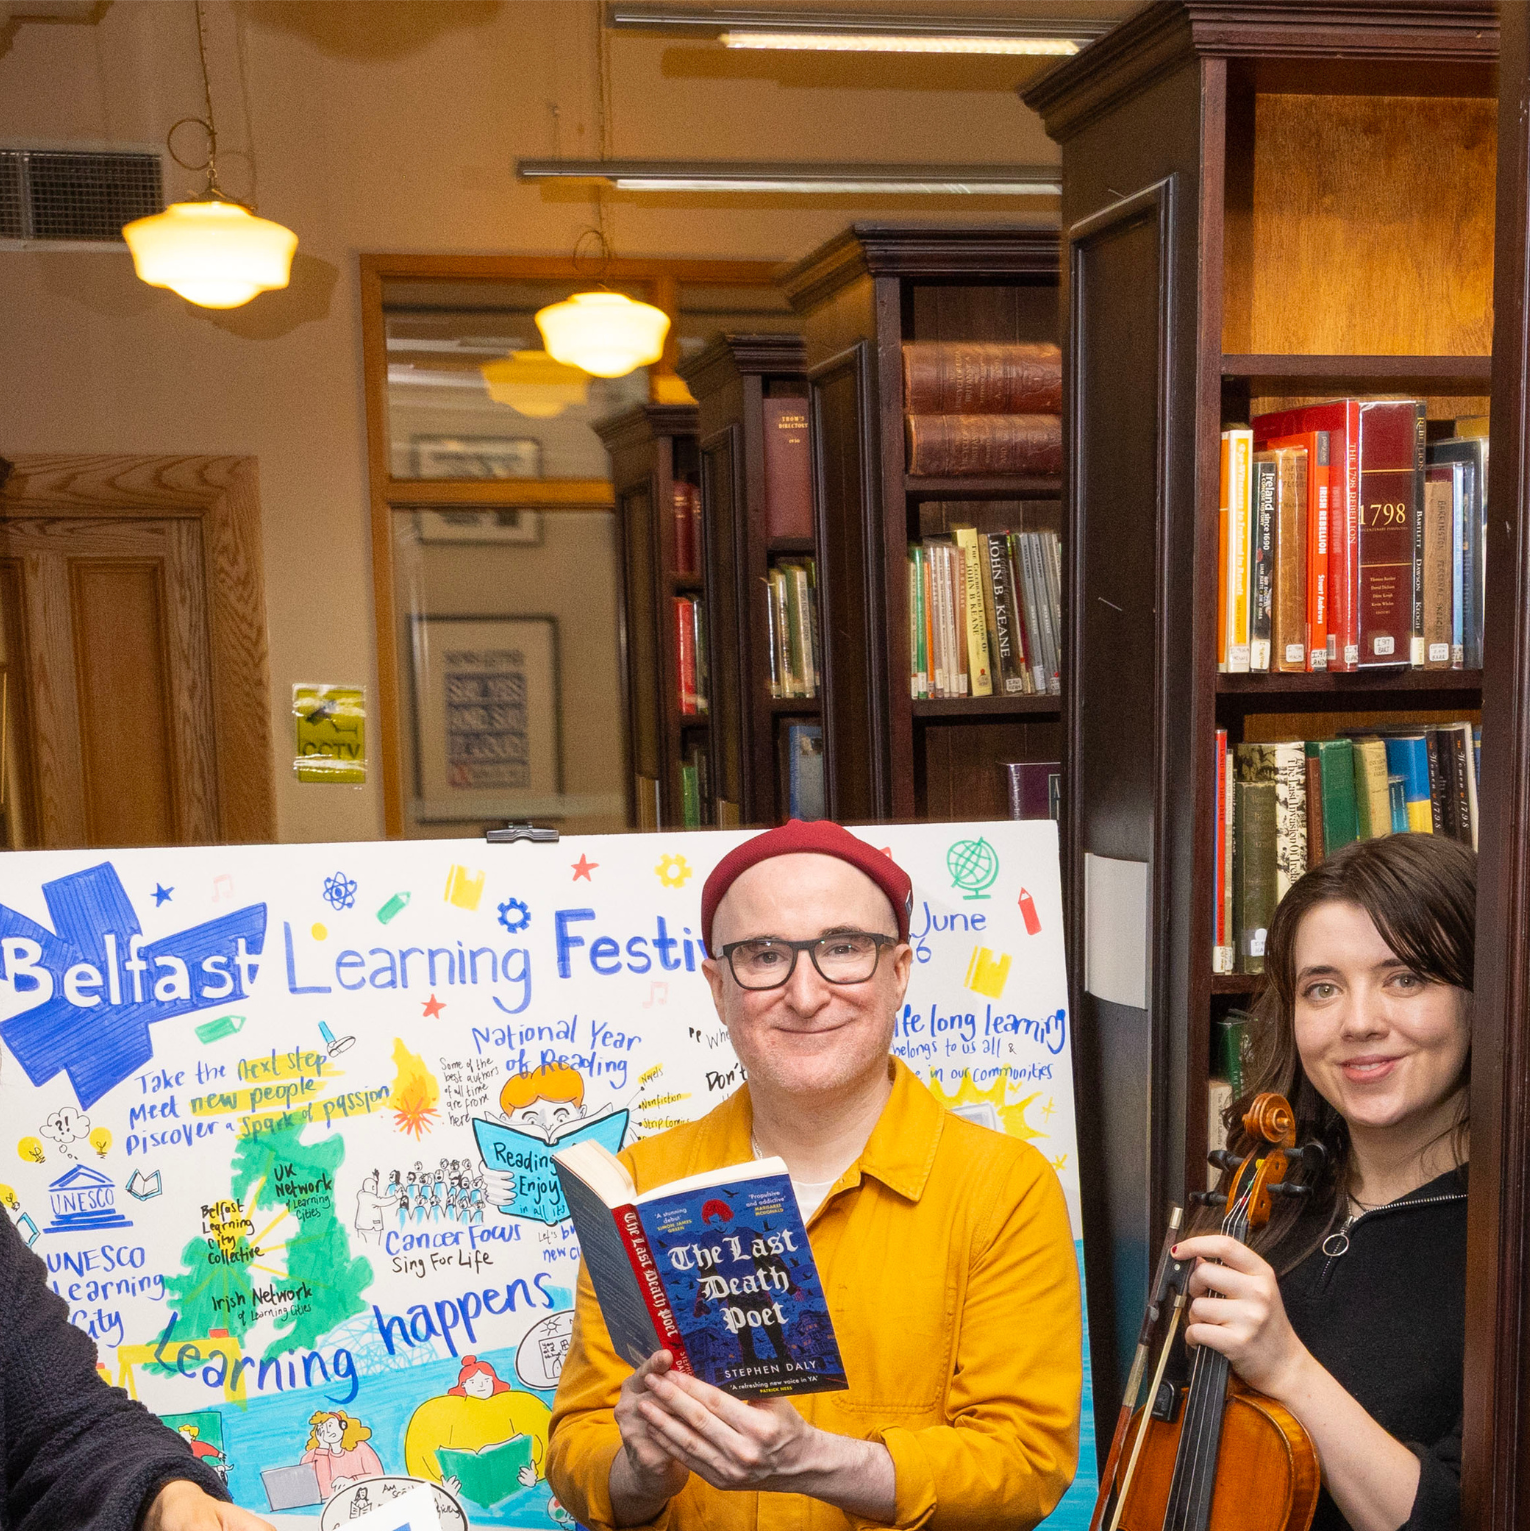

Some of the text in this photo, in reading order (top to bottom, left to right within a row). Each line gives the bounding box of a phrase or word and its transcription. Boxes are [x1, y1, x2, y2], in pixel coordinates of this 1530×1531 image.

[1264, 472, 1275, 511] Ireland
[1318, 486, 1328, 556] IRISH REBELLION
[1357, 502, 1407, 526] 1798
[988, 538, 1011, 658] JOHN KEANE
[303, 742, 360, 759] CCTV
[911, 902, 987, 938] June
[2, 921, 531, 1014] Belfast Learning
[472, 1015, 642, 1054] National Year
[931, 1003, 1066, 1054] long learning
[439, 1057, 493, 1071] Some the
[893, 1038, 1001, 1060] belongs to us all
[135, 1045, 328, 1095] Take the next step
[444, 1067, 499, 1084] best authors
[506, 1048, 628, 1090] of Reading
[973, 1063, 1053, 1082] communities
[129, 1078, 317, 1130] Meet new people
[125, 1084, 389, 1156] Discover spark passion
[274, 1163, 297, 1181] UK
[275, 1174, 333, 1198] Network
[49, 1190, 115, 1215] UNESCO
[201, 1200, 244, 1218] Belfast
[202, 1218, 255, 1235] Learning
[385, 1224, 522, 1256] Cancer Focus
[207, 1235, 236, 1250] City
[207, 1246, 265, 1266] Collective
[543, 1247, 566, 1263] new
[668, 1228, 799, 1272] The Last
[47, 1245, 146, 1276] UNESCO
[392, 1249, 494, 1278] Sing For Life
[623, 1212, 679, 1338] The Last Death Poet
[54, 1274, 165, 1304] Learning
[212, 1282, 313, 1313] Irish Network
[697, 1266, 789, 1301] Death
[71, 1307, 125, 1348] City
[251, 1302, 312, 1323] Learning Cities
[373, 1272, 555, 1358] happens
[721, 1301, 789, 1335] Poet
[154, 1311, 359, 1405] Learning
[724, 1361, 816, 1378] STEPHEN DALY
